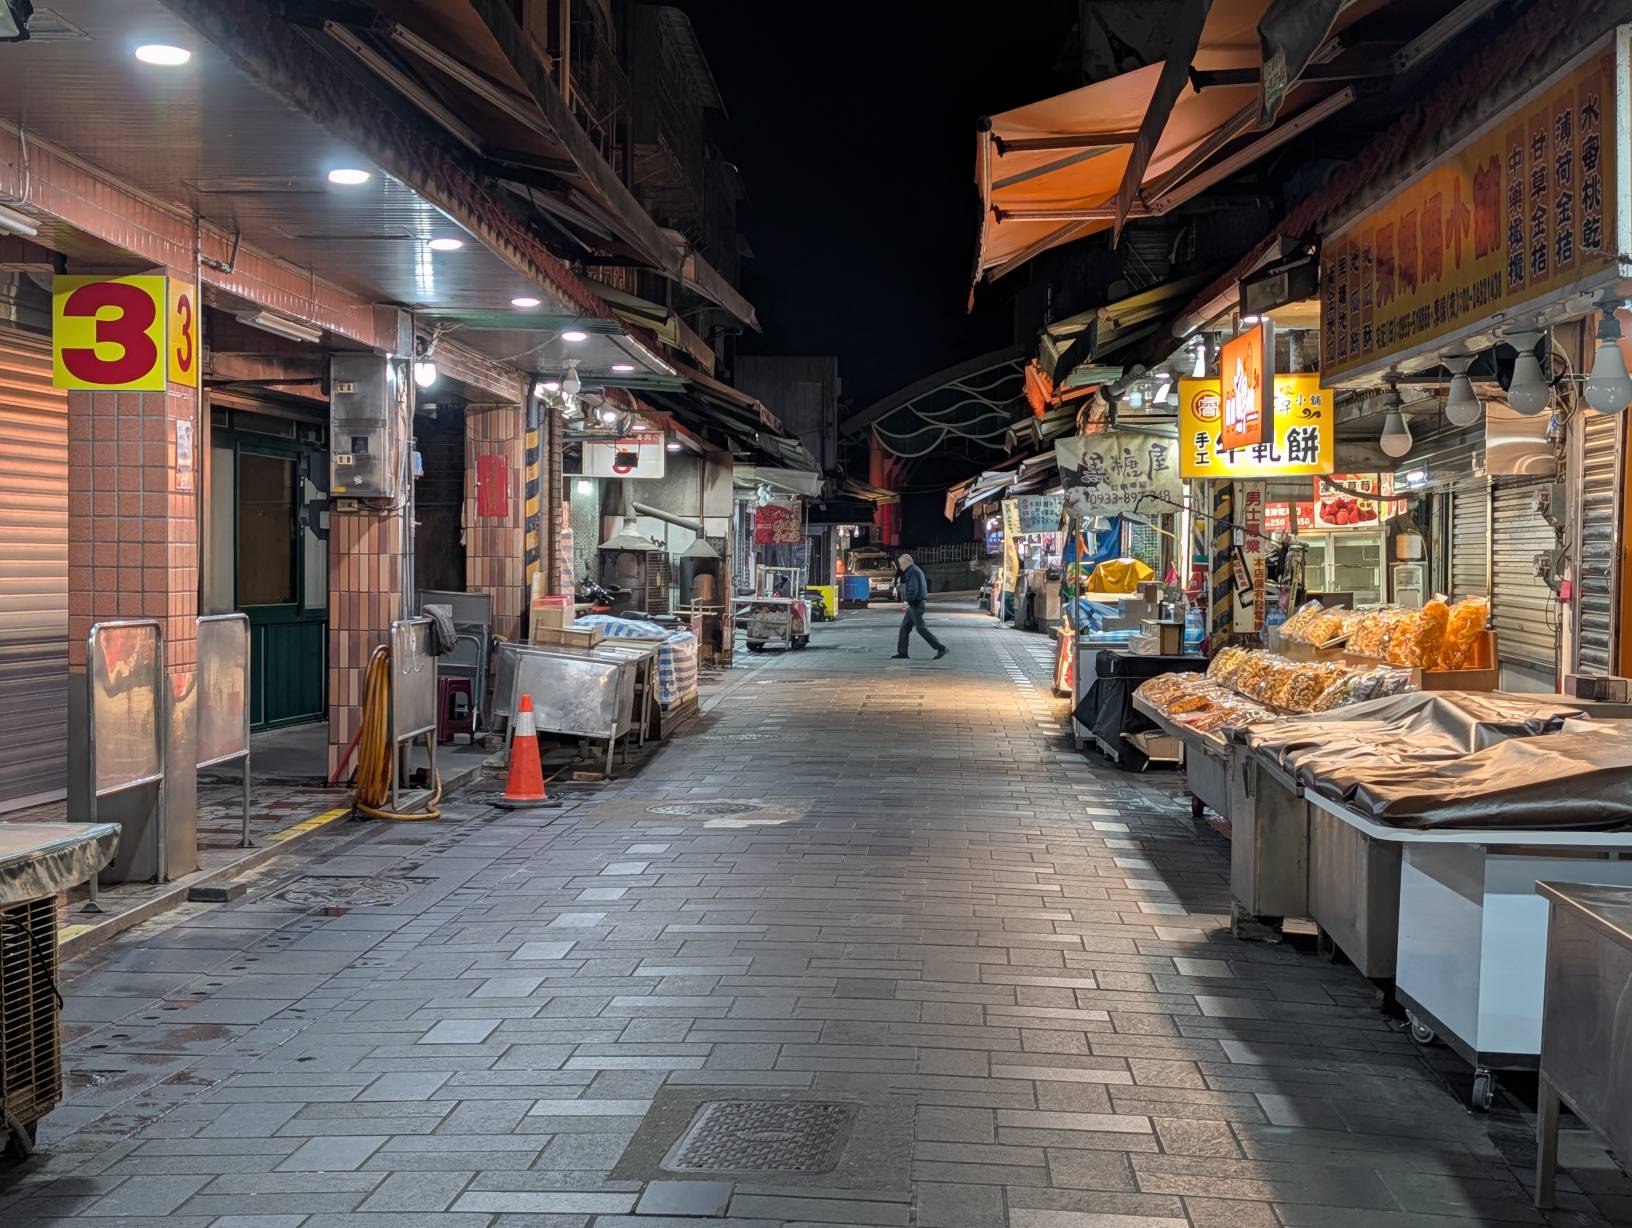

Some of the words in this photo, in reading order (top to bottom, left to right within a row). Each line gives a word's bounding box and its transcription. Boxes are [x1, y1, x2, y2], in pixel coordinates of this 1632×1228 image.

[1507, 143, 1525, 290] 中藥橄欖
[1530, 128, 1548, 281] 甘草金桔
[1554, 108, 1574, 266] 薄荷金桔
[1579, 92, 1602, 251] 水蜜桃乾
[62, 282, 158, 385] 3
[176, 293, 192, 372] 3
[1080, 442, 1170, 484] 黑糖屋
[1195, 432, 1211, 466] 手工
